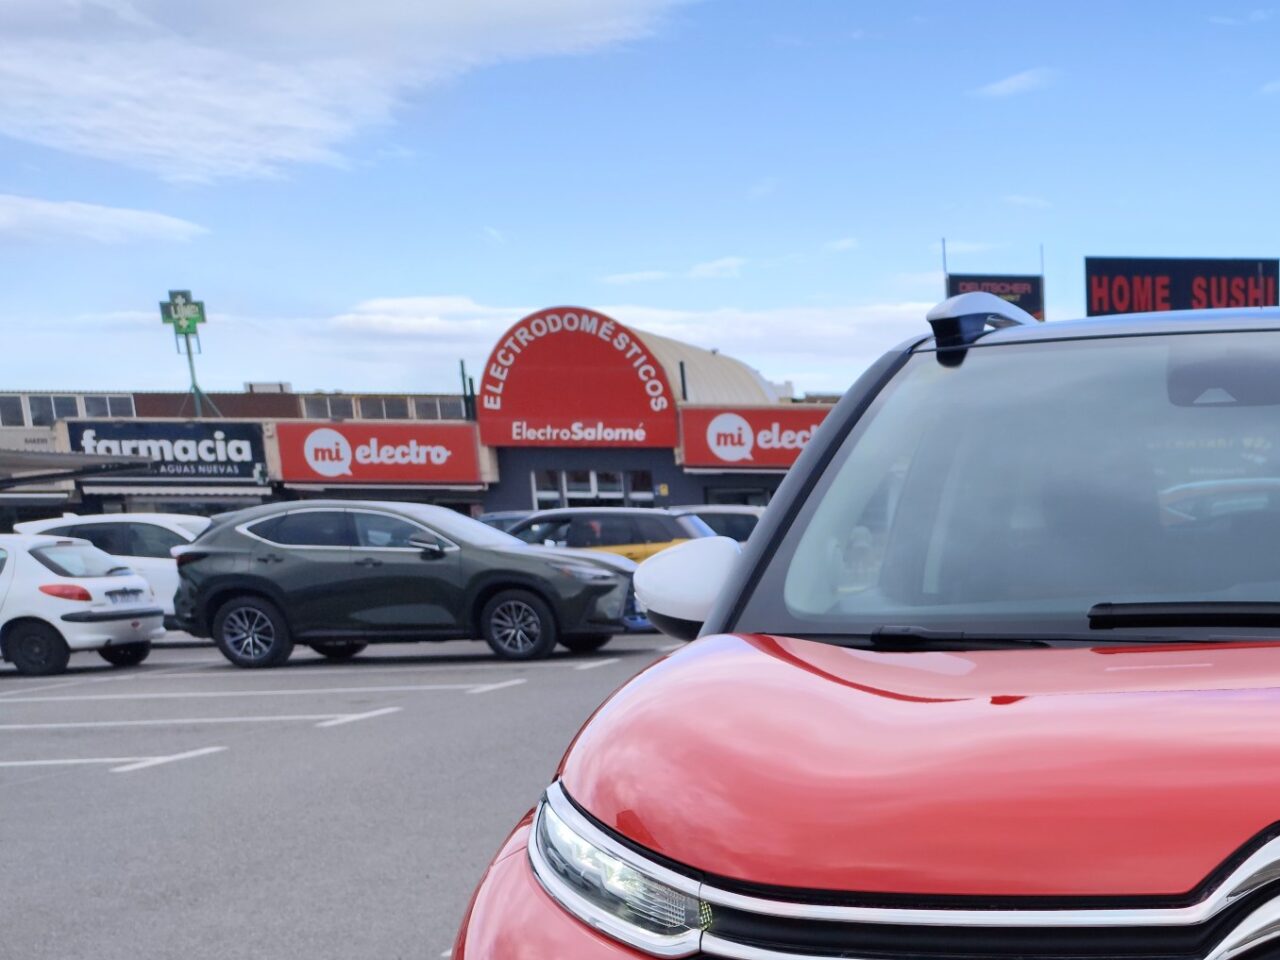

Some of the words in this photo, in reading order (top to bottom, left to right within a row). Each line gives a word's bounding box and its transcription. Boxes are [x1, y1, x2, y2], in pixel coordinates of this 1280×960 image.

[1090, 275, 1171, 312] HOME
[1192, 276, 1275, 310] SUSHI
[483, 312, 668, 412] ELECTRODOMÉSTICOS
[512, 421, 646, 441] ElectroSalomé
[716, 427, 745, 446] mi
[757, 422, 821, 449] elec
[81, 429, 252, 462] farmacia
[313, 442, 344, 462] mi
[355, 437, 451, 465] electro
[160, 465, 195, 474] AGUAS
[198, 464, 239, 474] NUEVAS
